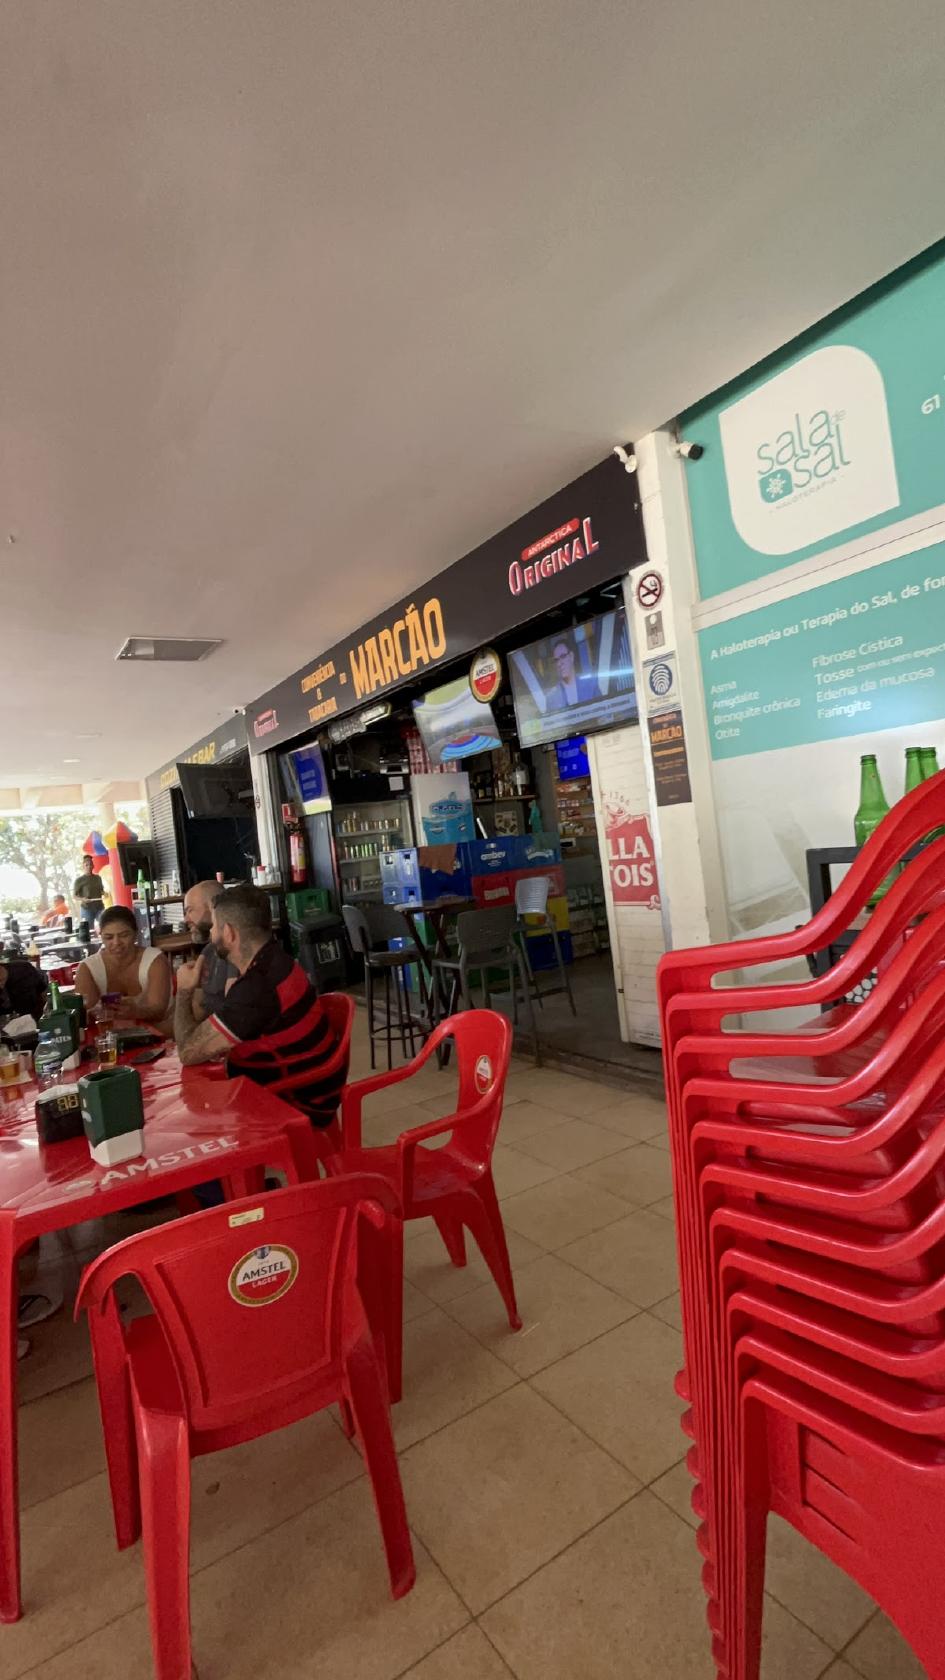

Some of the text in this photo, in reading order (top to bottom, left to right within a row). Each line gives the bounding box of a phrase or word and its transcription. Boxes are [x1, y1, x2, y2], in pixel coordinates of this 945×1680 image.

[757, 409, 834, 475] sala
[793, 423, 851, 488] sal
[719, 628, 781, 656] Haloterapia
[783, 624, 799, 637] ou
[800, 607, 848, 631] Terapia
[849, 602, 869, 615] do
[901, 584, 921, 599] de
[349, 597, 447, 700] MARCÃO
[812, 649, 857, 669] Fibrose
[814, 667, 856, 685] Tosse
[816, 666, 936, 703] Edema da mucosa
[817, 700, 873, 719] Faringite
[610, 862, 654, 888] OIS
[101, 1135, 240, 1186] AMSTEL
[241, 1260, 286, 1282] AMSTEL
